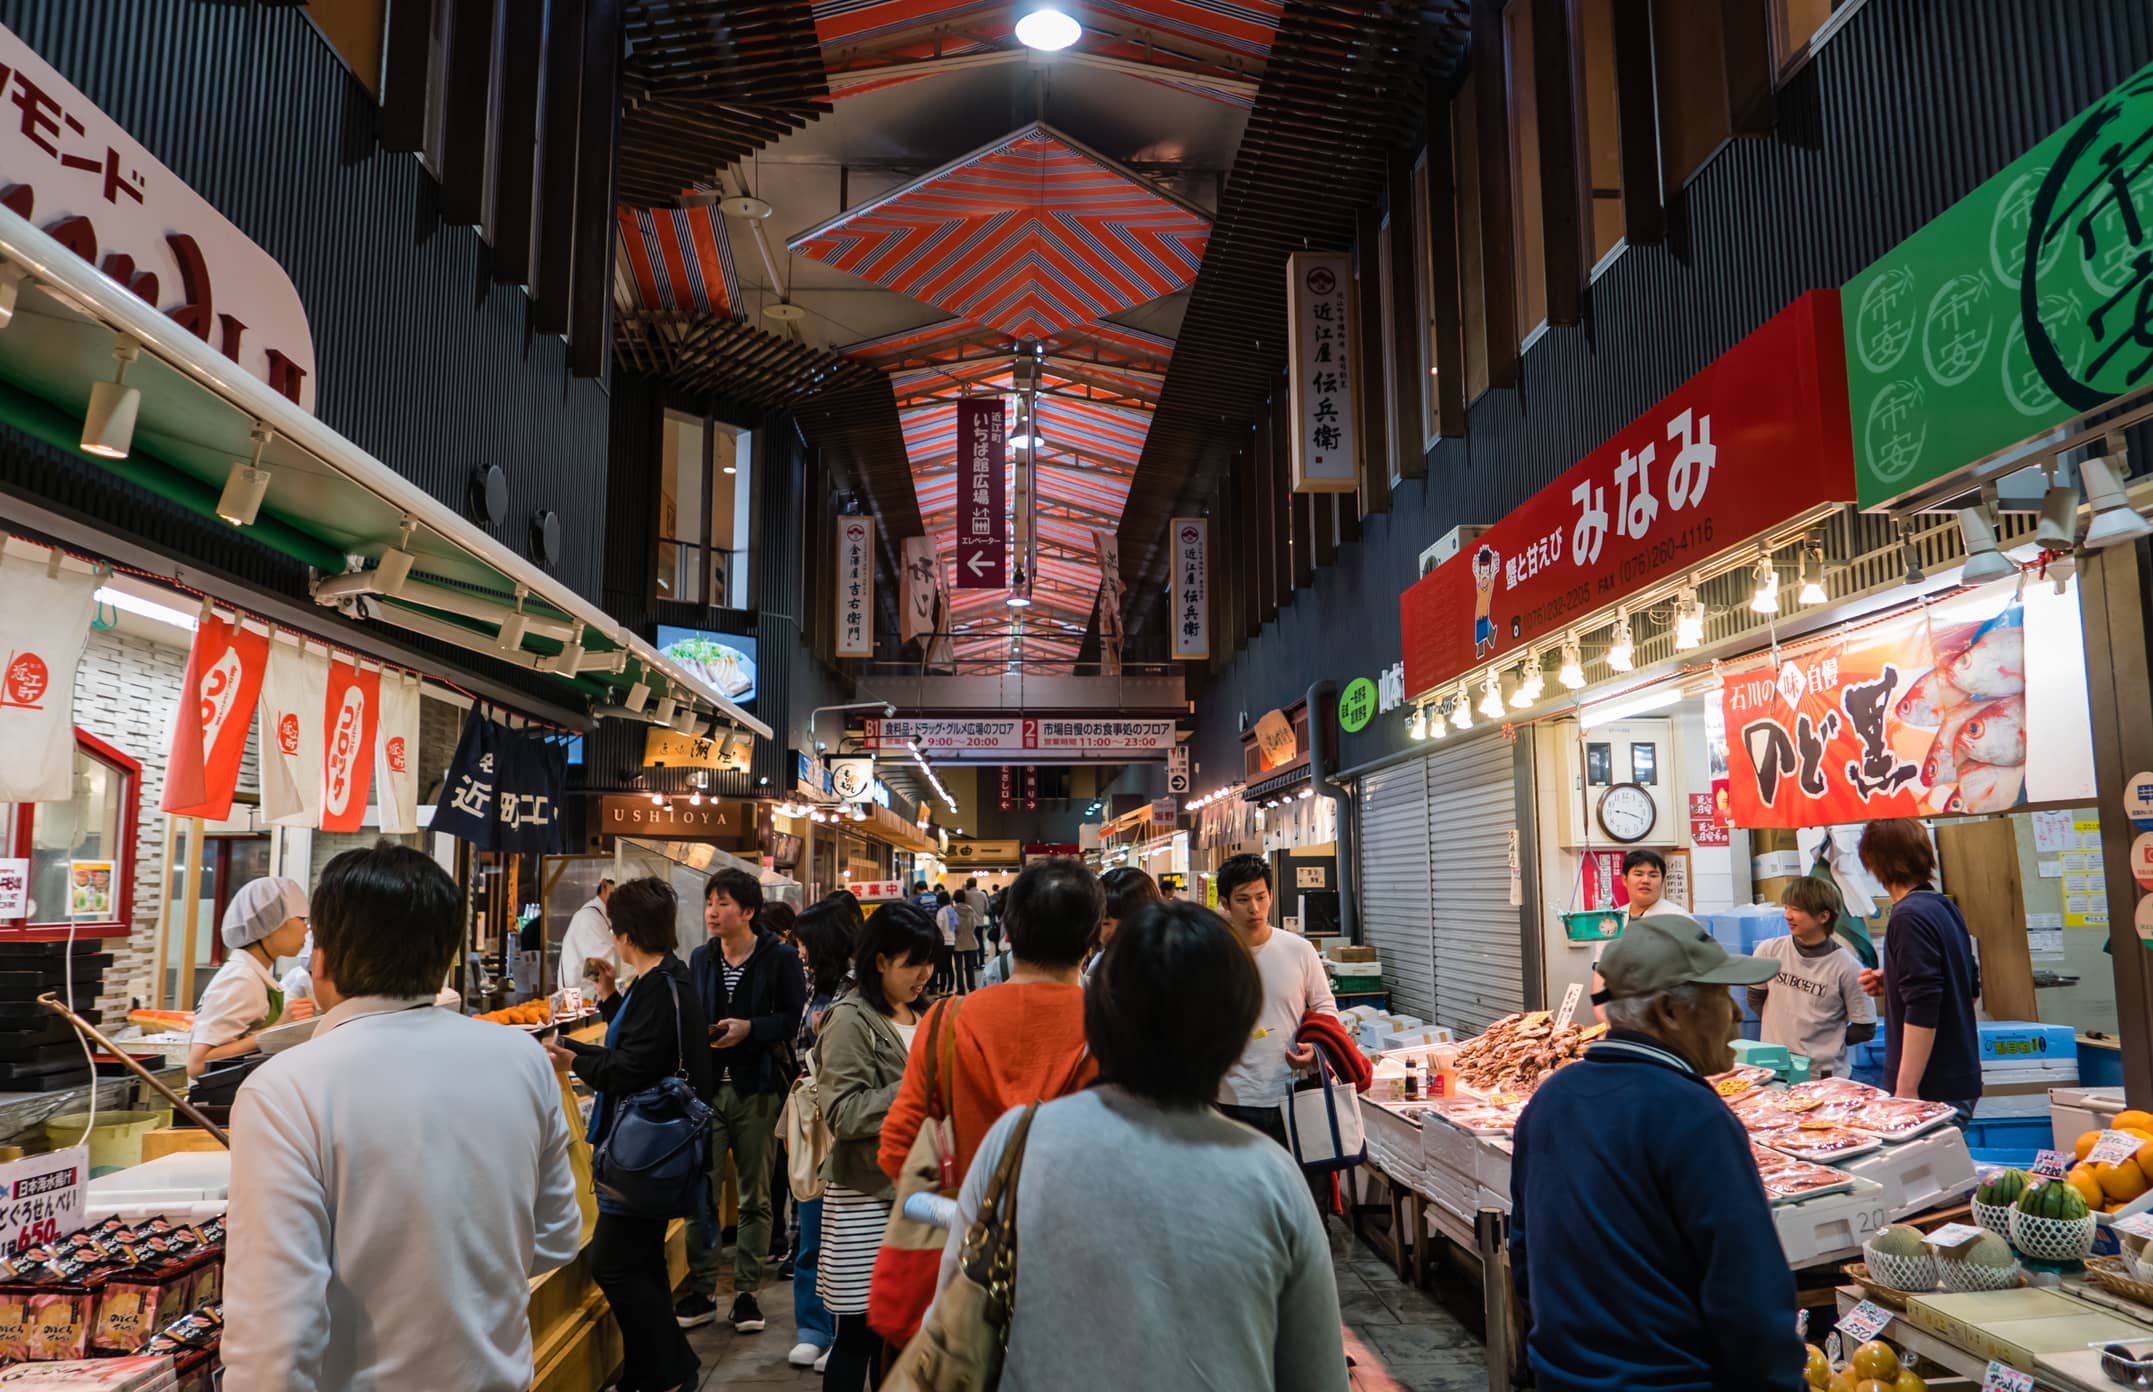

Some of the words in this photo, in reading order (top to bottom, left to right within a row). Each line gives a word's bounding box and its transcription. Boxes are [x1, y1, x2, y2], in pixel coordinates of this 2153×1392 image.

[0, 62, 145, 205] モンド
[1313, 302, 1341, 450] 近江屋伝兵衛
[991, 412, 1001, 443] 近江町
[973, 413, 989, 505] いちば館広場
[1572, 407, 1717, 566] みなみ
[962, 537, 1000, 545] エレベーター
[1505, 526, 1563, 591] 蟹と甘えび
[1598, 576, 1615, 593] FAX
[1619, 518, 1712, 584] (076)260-4116
[1183, 548, 1200, 637] 近江屋伝兵衛
[1730, 657, 1838, 711] 石川の味自慢
[331, 705, 354, 801] コロッケ
[866, 721, 880, 737] B1
[1024, 721, 1036, 737] 2
[1043, 722, 1170, 736] 市場自慢のお食事処のフロア
[614, 808, 727, 825] USHIOYA
[851, 883, 898, 897] 営業中
[1856, 1208, 1885, 1233] 20
